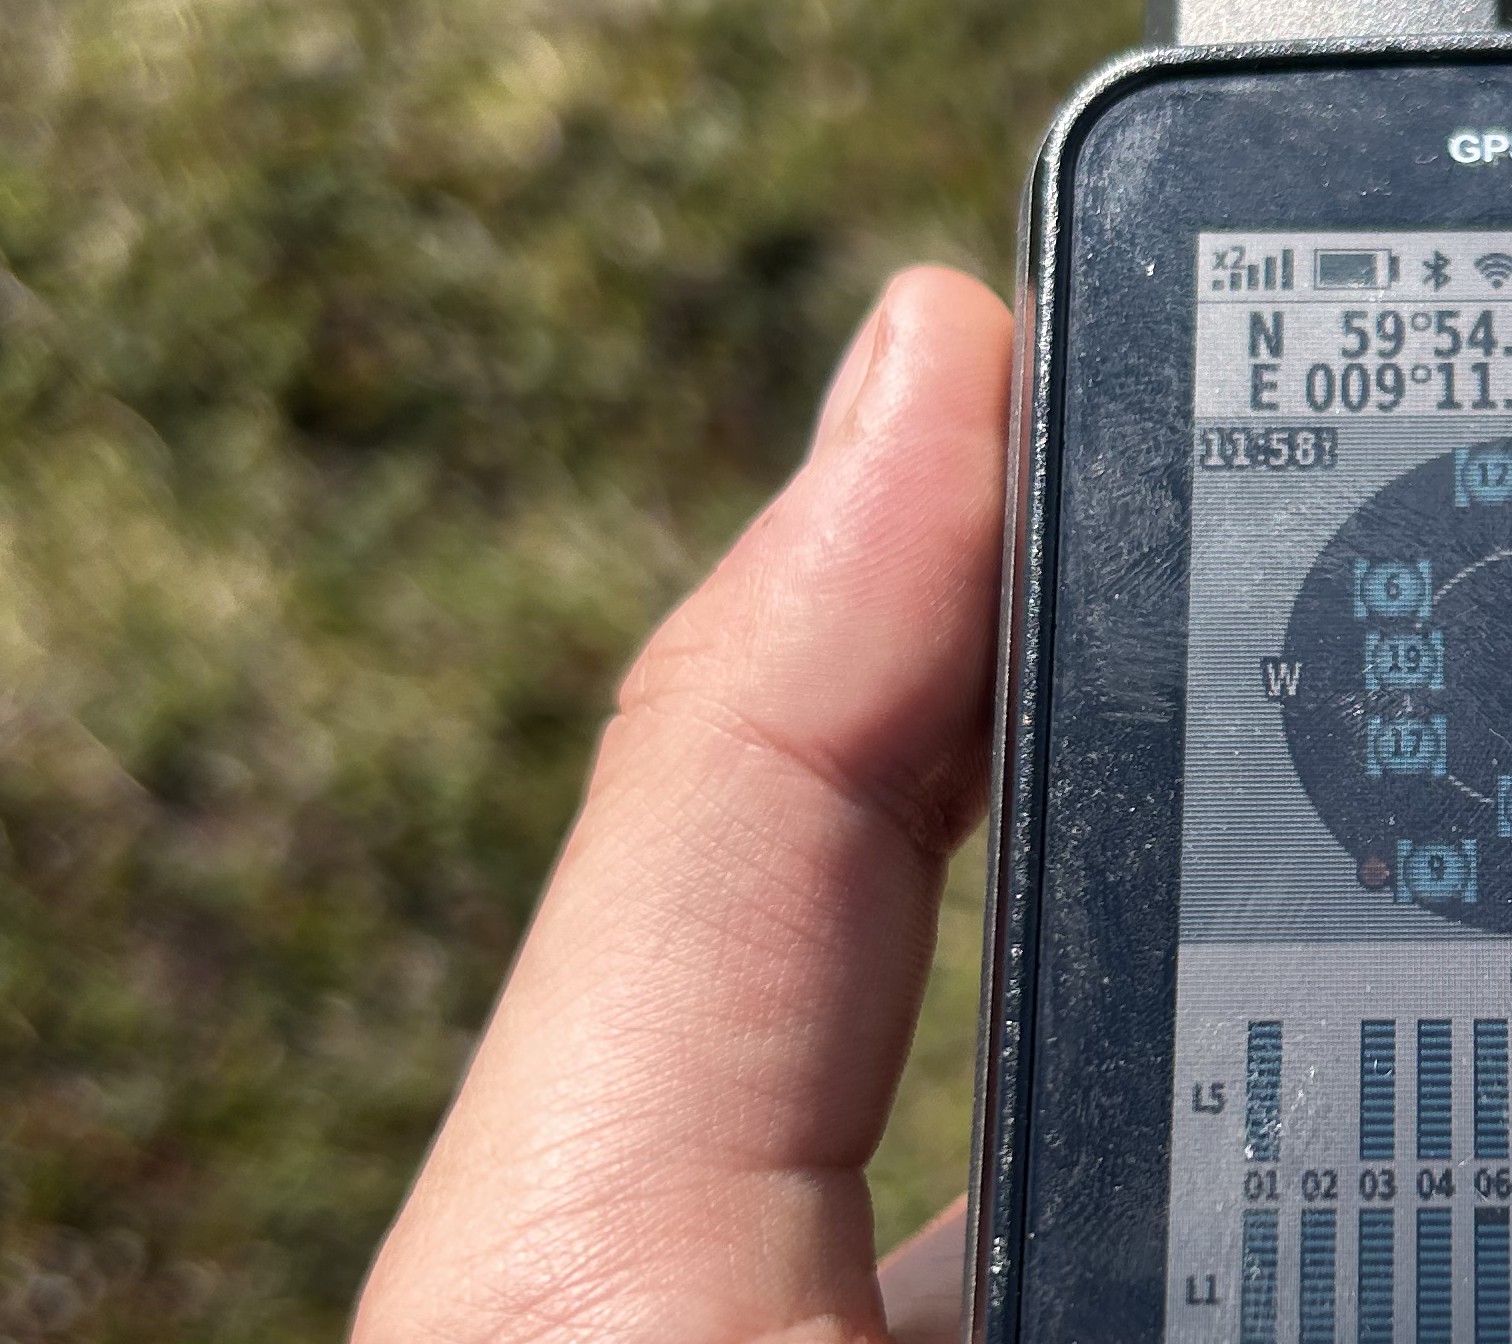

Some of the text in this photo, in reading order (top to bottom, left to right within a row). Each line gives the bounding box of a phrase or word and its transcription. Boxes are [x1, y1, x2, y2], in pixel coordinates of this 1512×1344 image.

[1250, 309, 1285, 359] N
[1250, 363, 1281, 412] E
[1267, 661, 1302, 696] W
[1192, 1082, 1227, 1115] L5
[1244, 1169, 1280, 1201] 01
[1301, 1168, 1339, 1201] 02
[1359, 1168, 1397, 1201] 03
[1416, 1168, 1456, 1201] 04
[1185, 1273, 1221, 1306] L1
